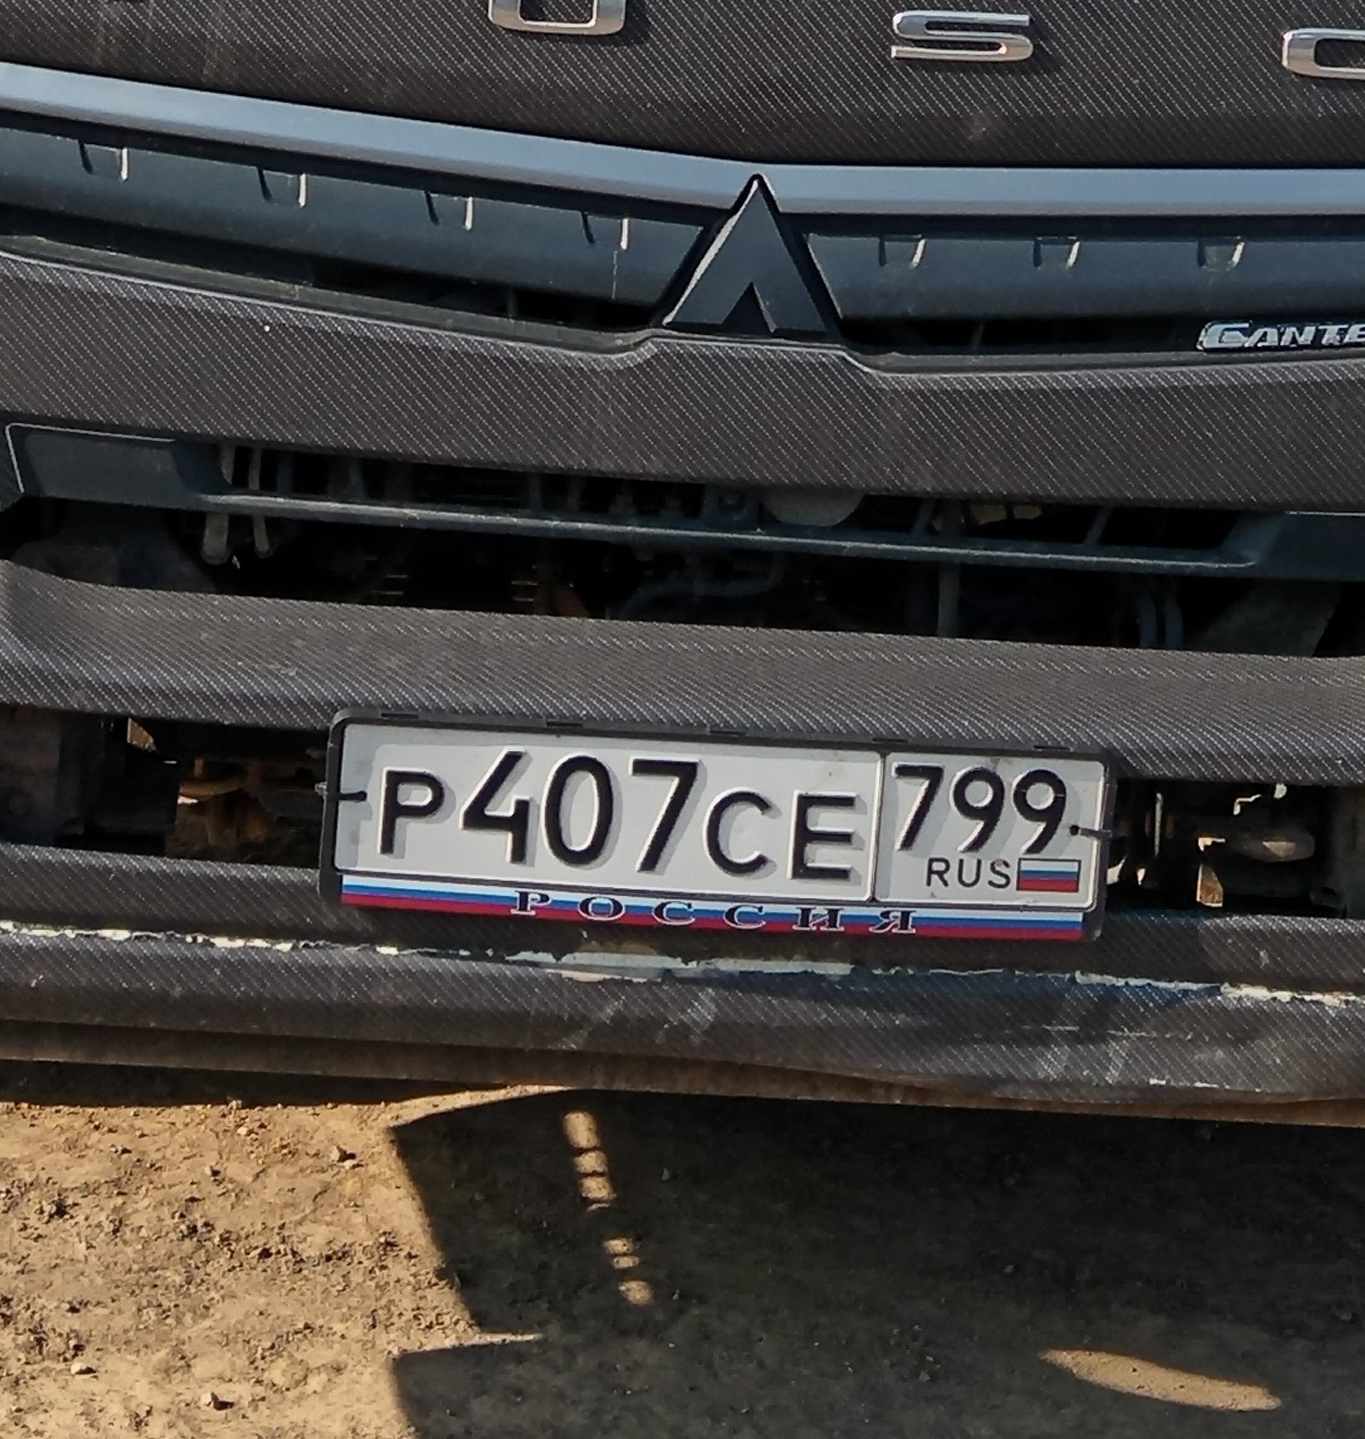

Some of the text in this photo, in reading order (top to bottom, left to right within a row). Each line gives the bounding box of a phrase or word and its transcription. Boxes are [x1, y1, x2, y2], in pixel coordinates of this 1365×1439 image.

[892, 763, 1069, 854] 799
[925, 856, 1012, 890] RUS
[511, 890, 917, 935] РОССИЯ
